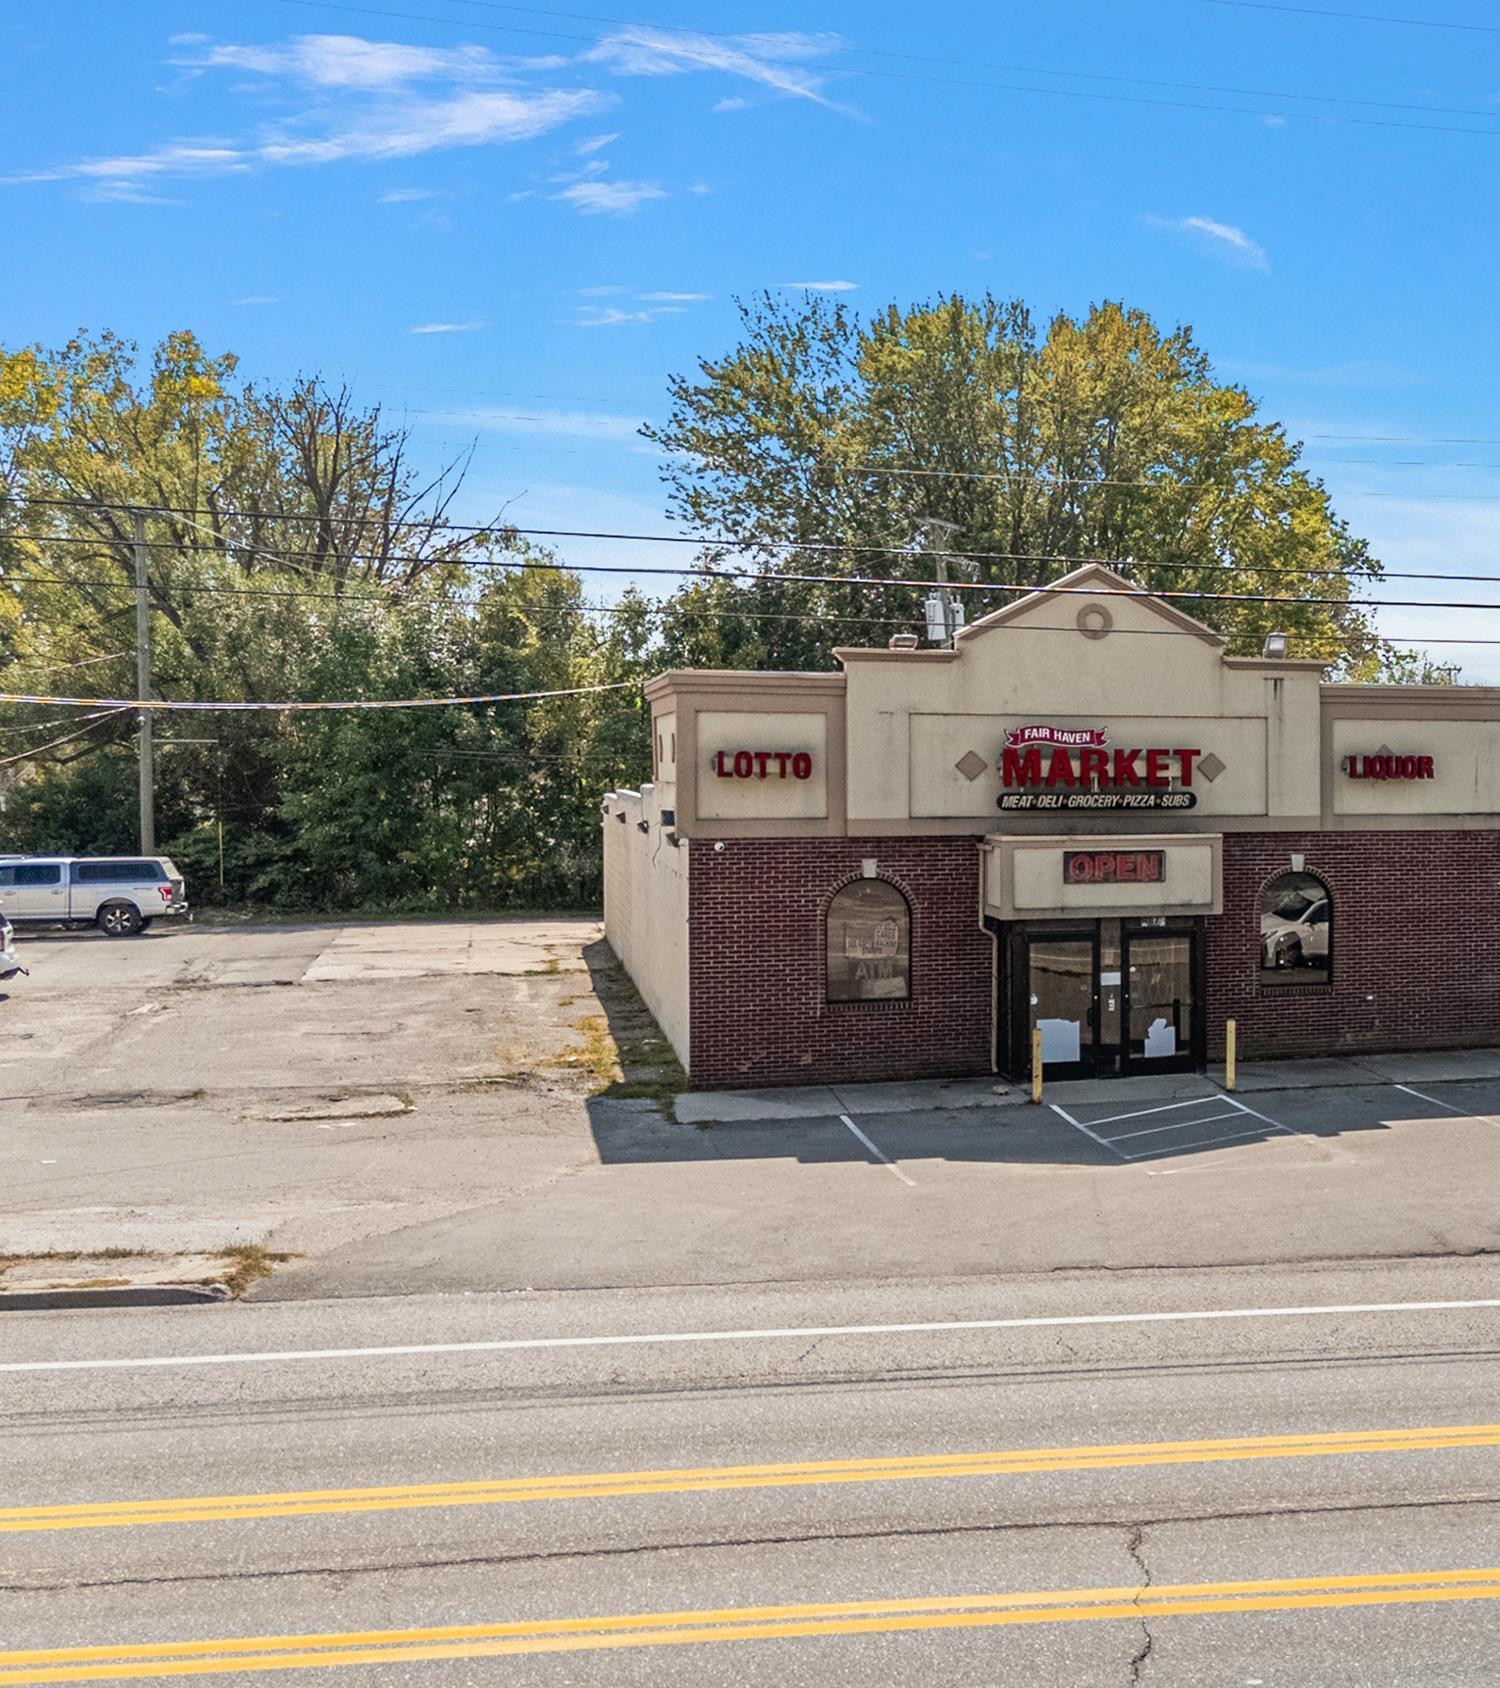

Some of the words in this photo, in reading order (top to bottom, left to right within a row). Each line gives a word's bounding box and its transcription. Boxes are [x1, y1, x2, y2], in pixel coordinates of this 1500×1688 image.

[1024, 727, 1050, 740] FAIR
[1053, 728, 1091, 744] HAVEN
[717, 751, 812, 779] LOTTO
[1003, 748, 1201, 787] MARKET
[1349, 755, 1434, 780] LIQUOR
[1000, 795, 1032, 808] MEAT
[1037, 795, 1062, 808] DELI
[1067, 795, 1118, 808] GROCERY
[1123, 795, 1155, 808] PIZZA
[1161, 795, 1191, 808] SUBS
[1070, 855, 1158, 881] OPEN
